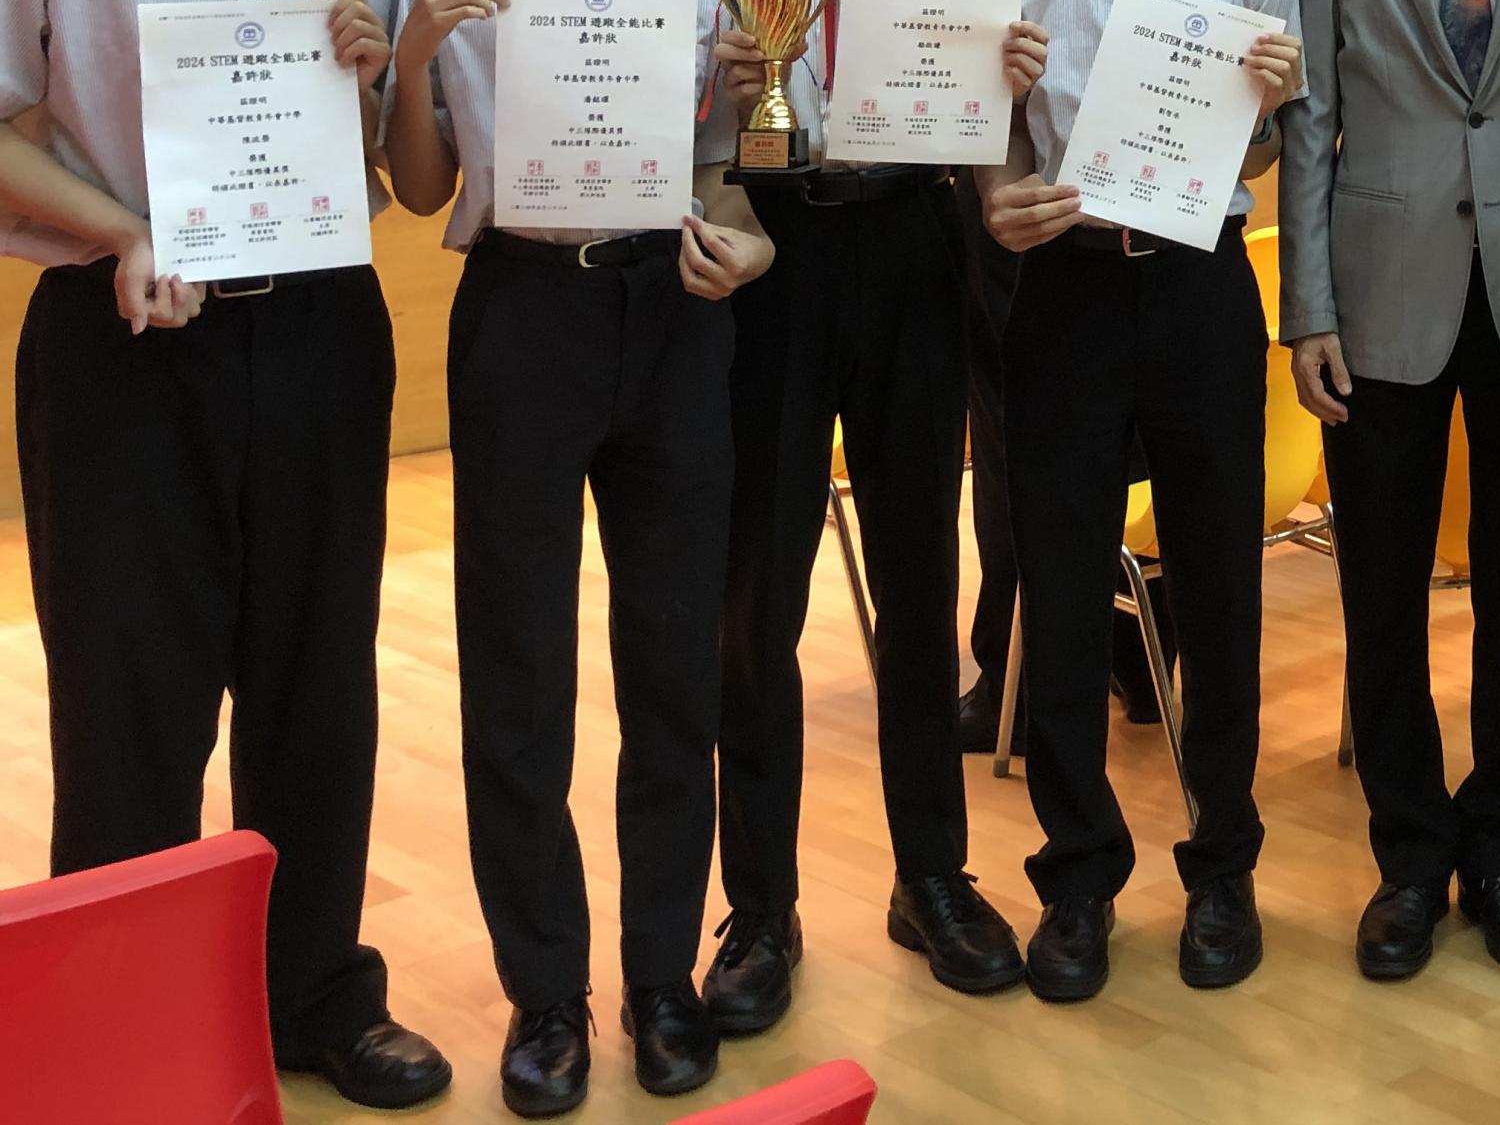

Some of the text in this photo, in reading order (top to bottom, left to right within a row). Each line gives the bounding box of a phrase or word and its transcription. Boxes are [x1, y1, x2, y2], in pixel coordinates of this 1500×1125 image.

[530, 16, 555, 26] 2024
[560, 16, 587, 27] STEM
[1134, 25, 1156, 40] 2024
[1159, 32, 1182, 47] STEM
[177, 57, 204, 69] 2024
[210, 55, 238, 67] STEM
